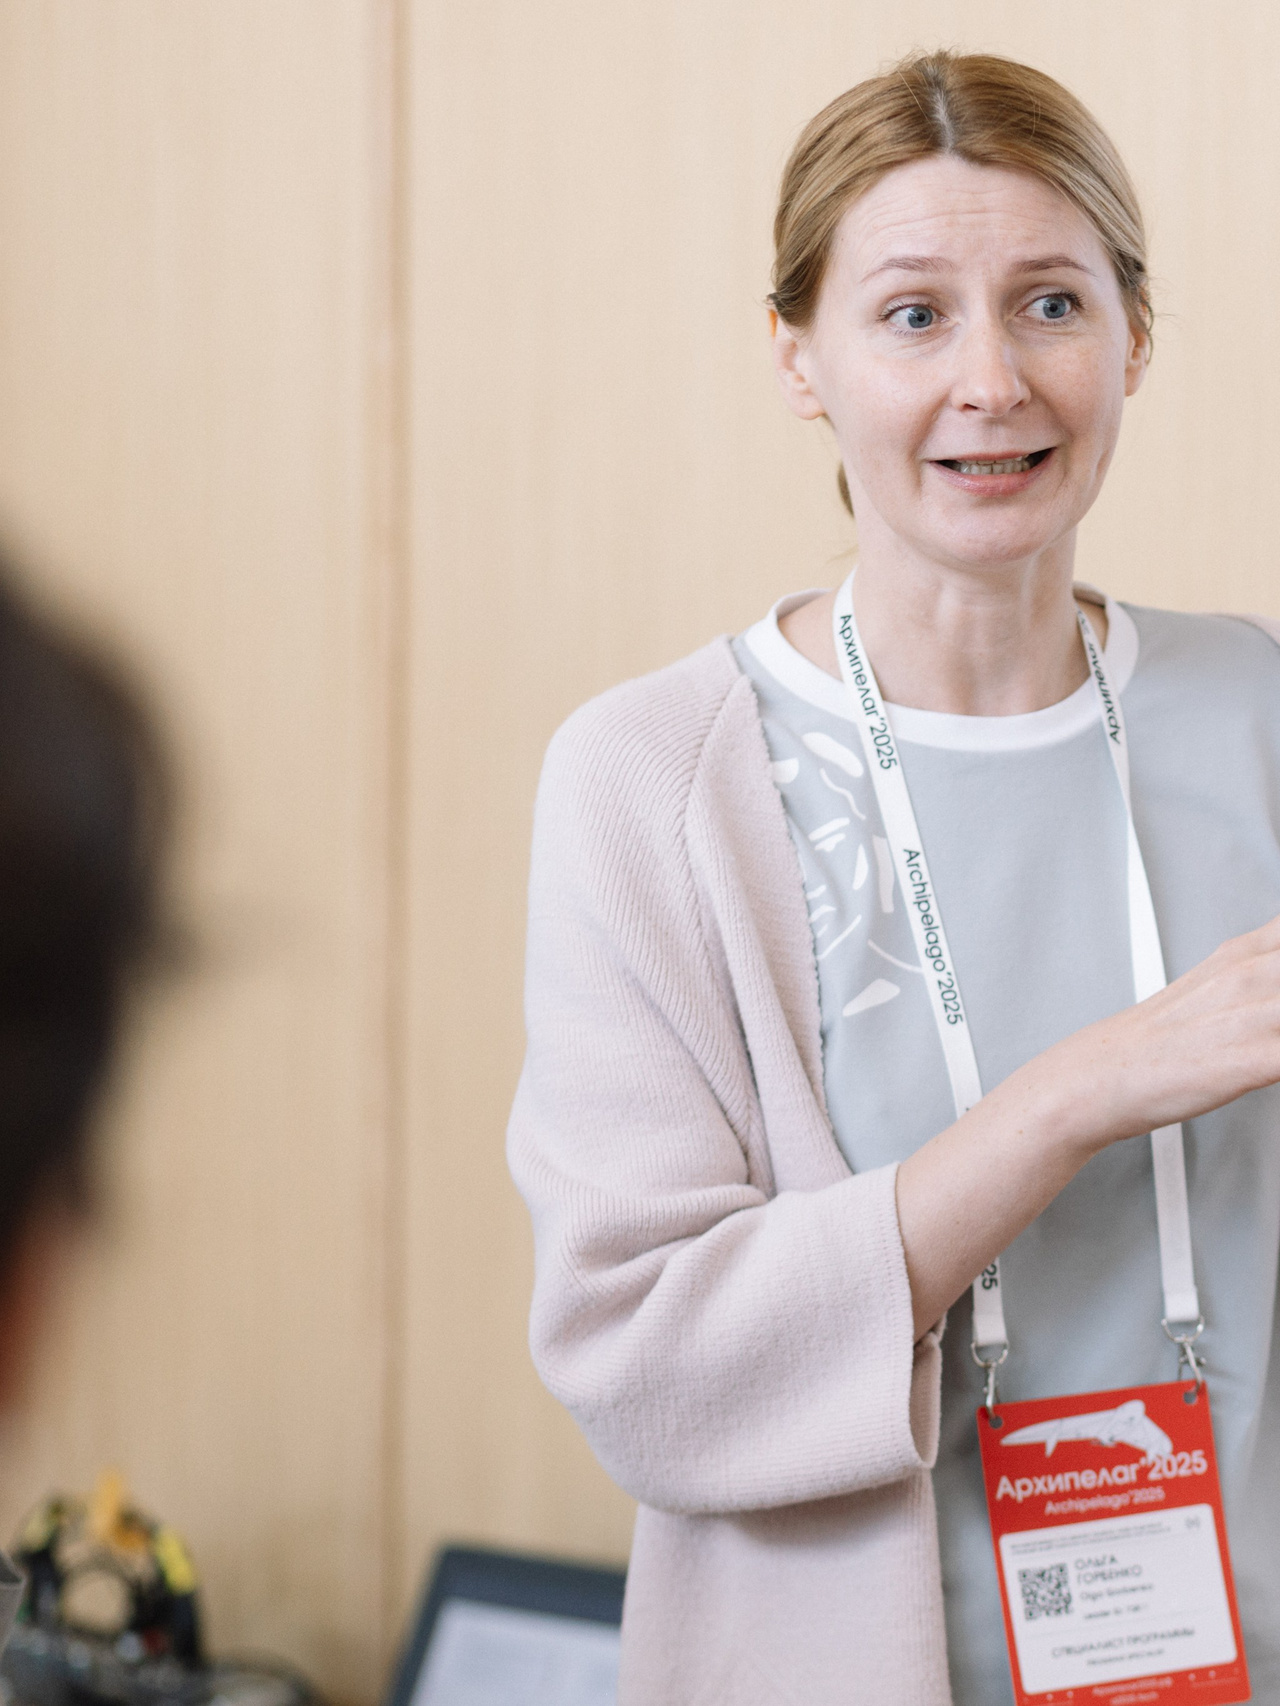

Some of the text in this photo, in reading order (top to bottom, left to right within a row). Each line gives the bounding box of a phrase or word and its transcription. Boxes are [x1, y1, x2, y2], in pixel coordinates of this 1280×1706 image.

[839, 614, 898, 770] Архипелаг'2025
[903, 848, 964, 1026] Archipelago'2025
[996, 1449, 1208, 1503] Архипелаг'2025
[1074, 1554, 1118, 1571] ОЛЬГА
